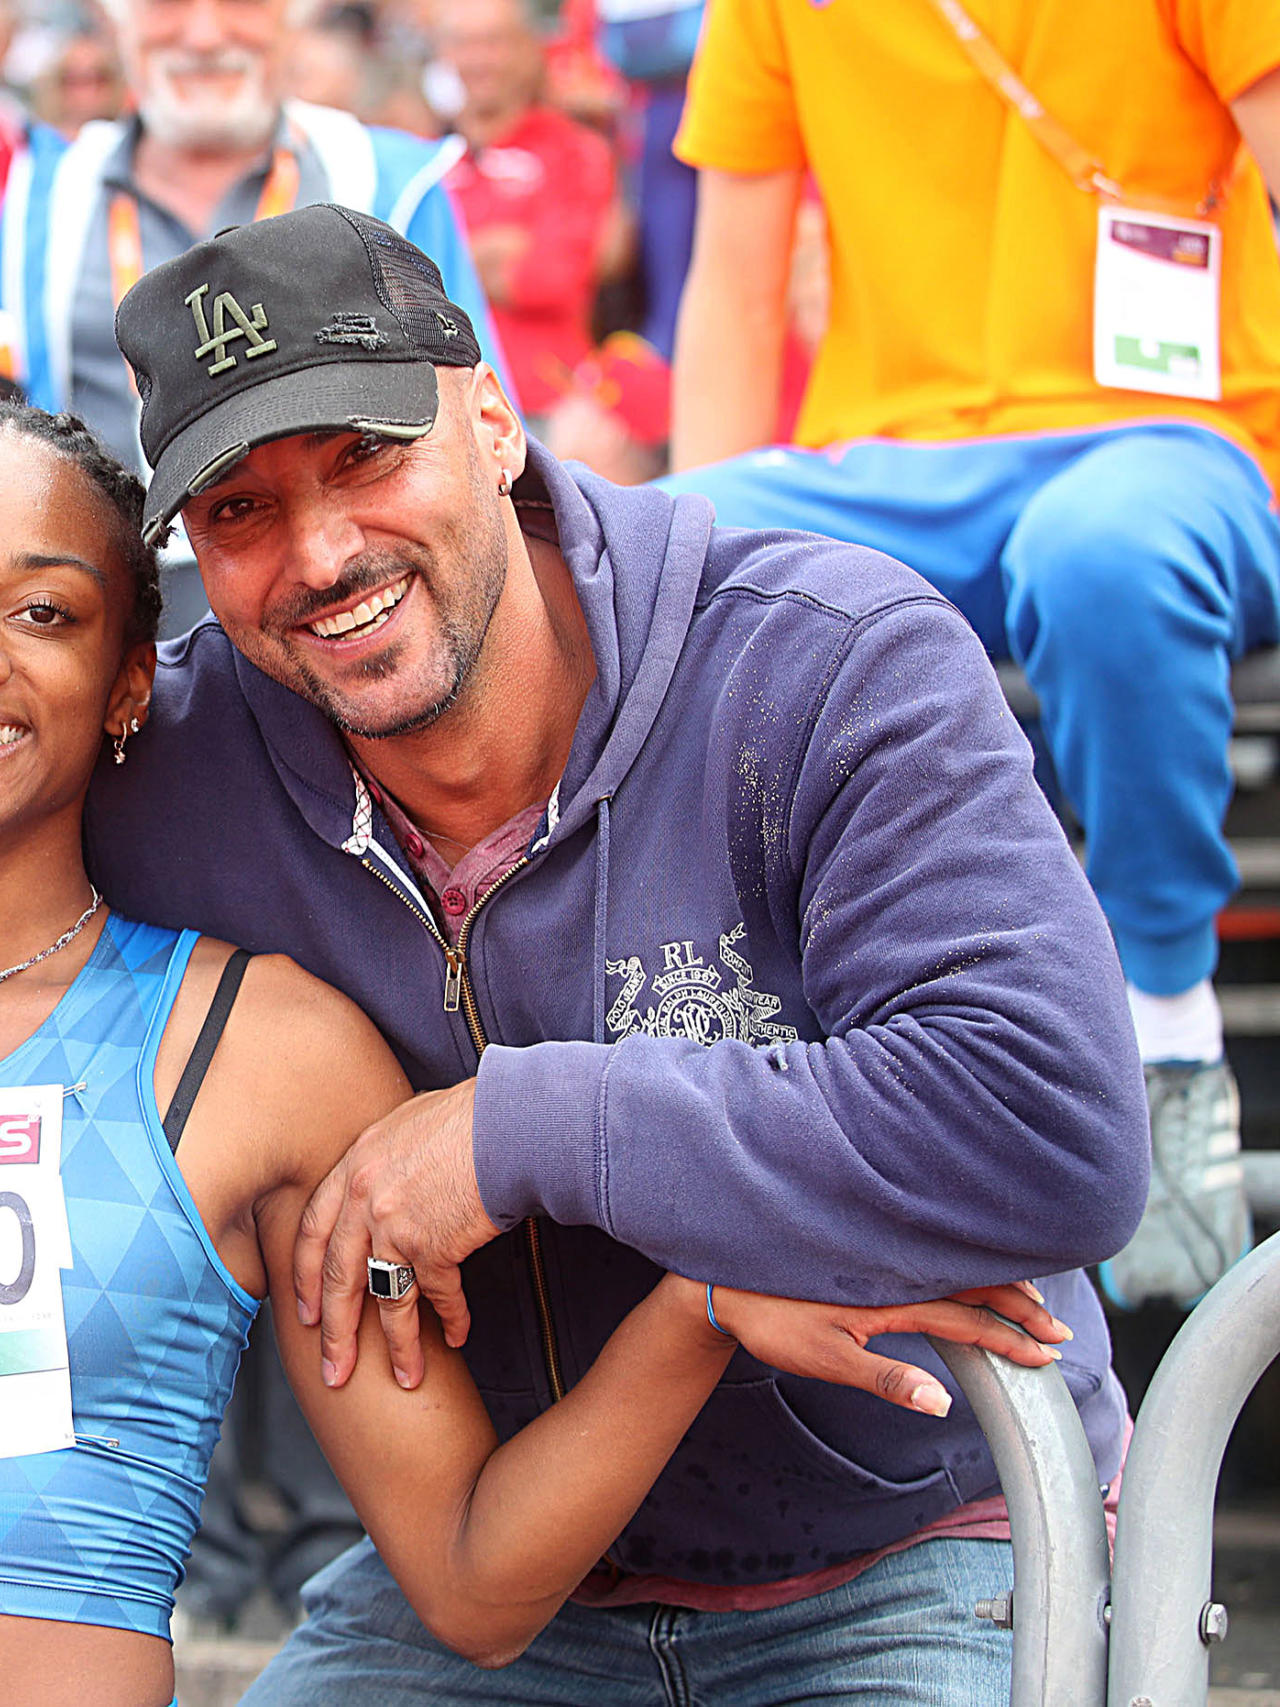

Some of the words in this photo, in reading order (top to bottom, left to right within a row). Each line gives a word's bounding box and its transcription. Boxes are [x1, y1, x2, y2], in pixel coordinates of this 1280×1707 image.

[184, 283, 277, 376] LA
[660, 941, 703, 971] RL
[660, 973, 688, 990] SINCE
[691, 970, 716, 984] 1967
[609, 1000, 626, 1026] POLO
[623, 971, 642, 1001] JEANS
[662, 989, 689, 1013] RALPH
[691, 988, 726, 1014] LAUREN
